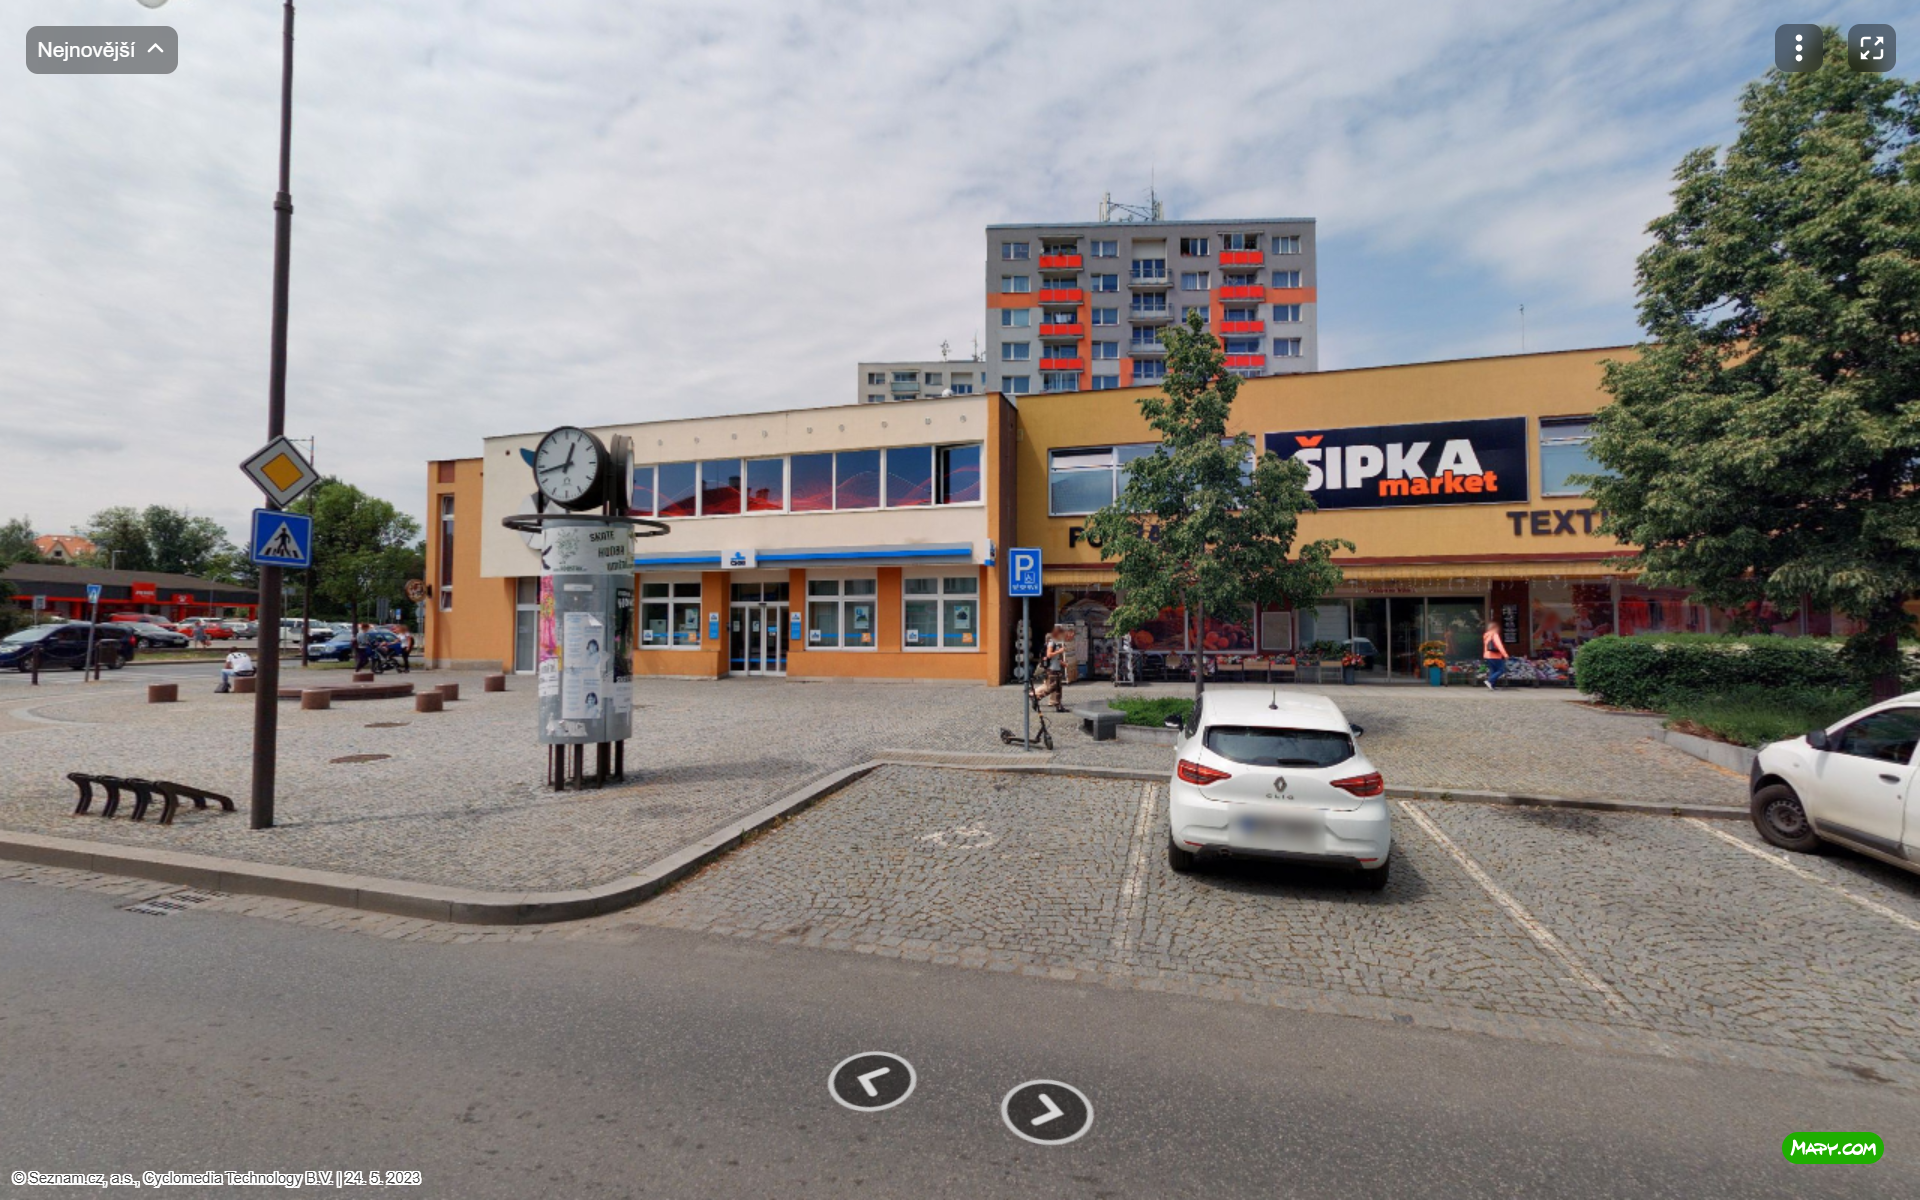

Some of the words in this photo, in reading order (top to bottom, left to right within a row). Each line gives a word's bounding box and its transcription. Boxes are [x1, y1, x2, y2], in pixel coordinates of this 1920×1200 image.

[1293, 435, 1484, 491] ŠIPKA
[1378, 470, 1498, 498] market
[1014, 554, 1035, 582] P
